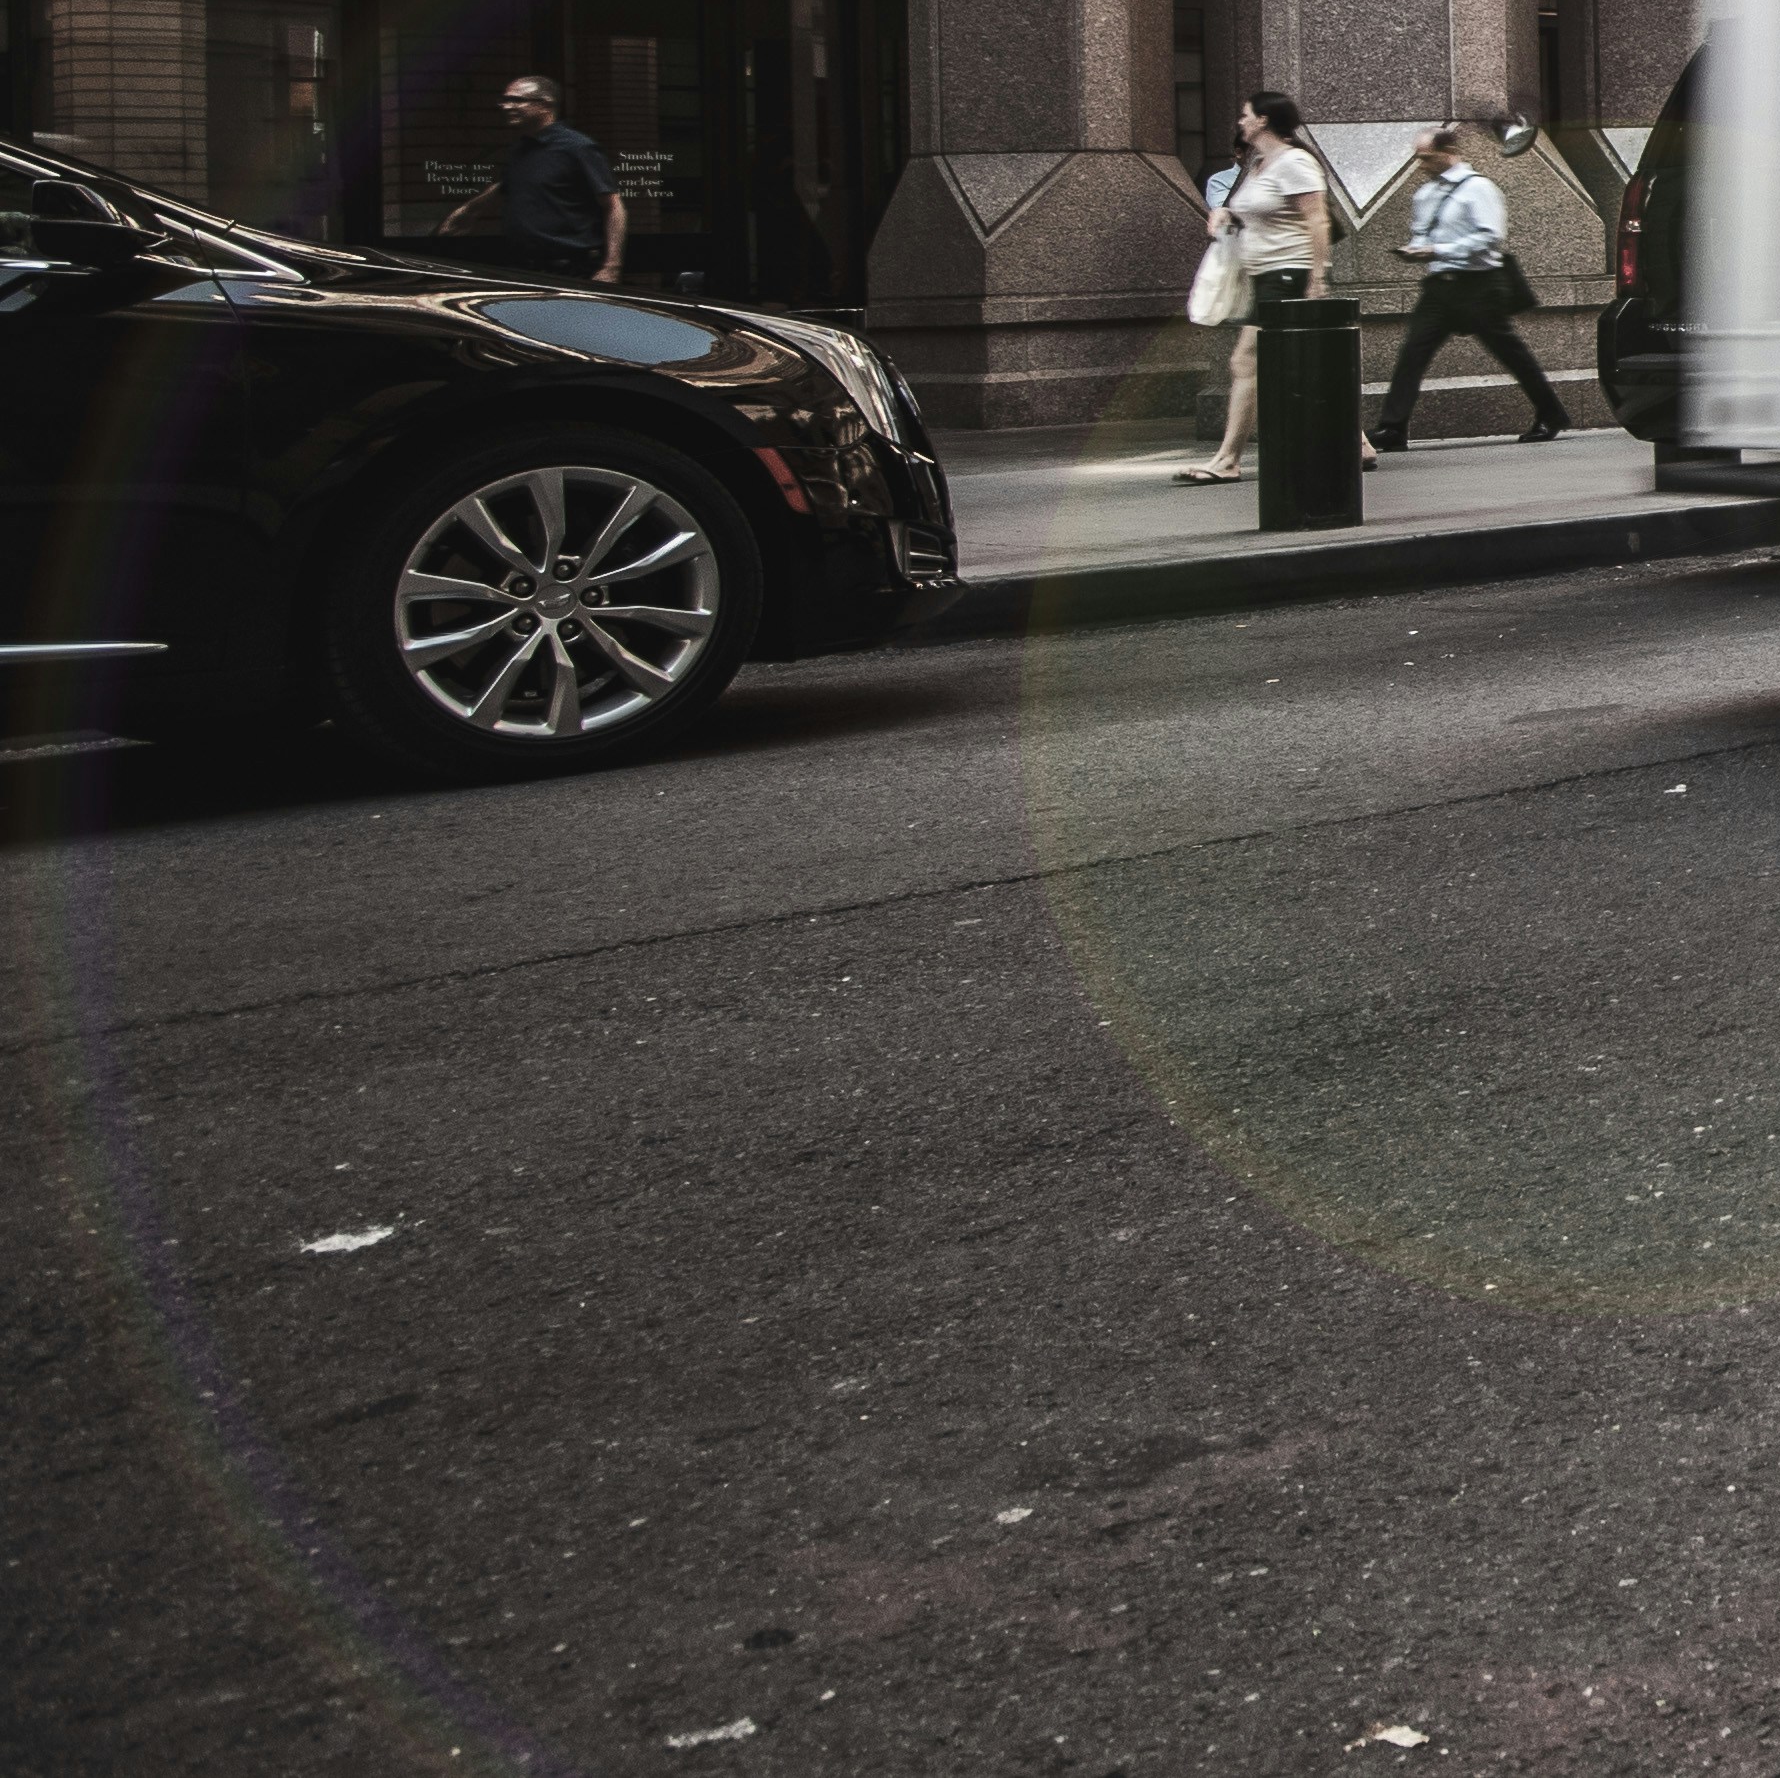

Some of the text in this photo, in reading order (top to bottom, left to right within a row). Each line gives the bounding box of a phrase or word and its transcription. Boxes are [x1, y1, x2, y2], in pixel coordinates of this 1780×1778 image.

[619, 150, 674, 162] Smoking
[424, 160, 467, 171] Please
[612, 162, 661, 172] allowed
[426, 172, 494, 184] Revolving
[440, 184, 480, 195] Doors
[646, 188, 675, 198] Area
